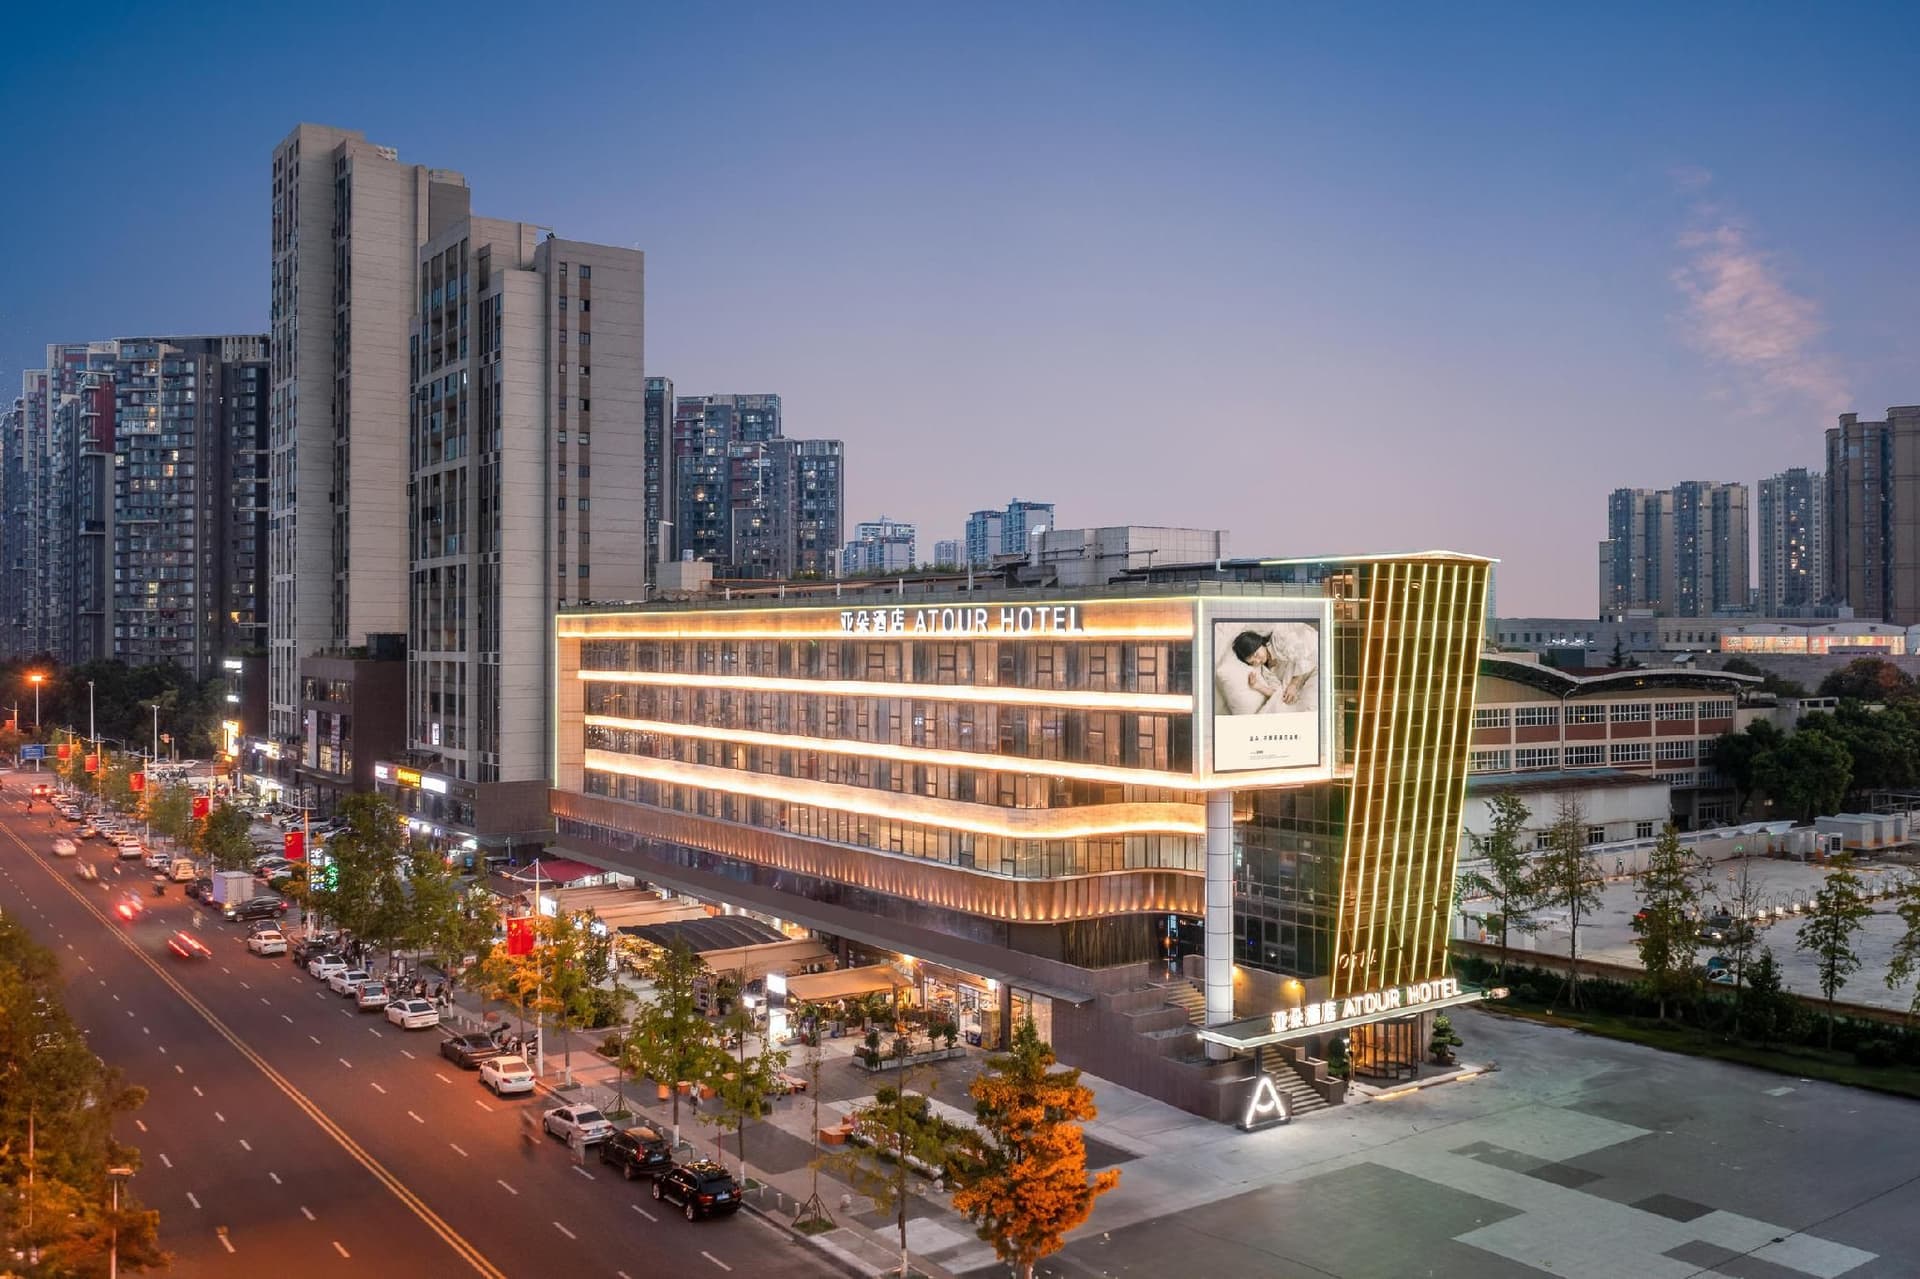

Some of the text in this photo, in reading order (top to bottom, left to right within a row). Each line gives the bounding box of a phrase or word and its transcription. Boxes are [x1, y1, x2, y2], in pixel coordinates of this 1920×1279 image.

[841, 606, 1084, 633] 亚朵酒店 ATOUR HOTEL
[1342, 988, 1400, 1018] ATOUR
[1407, 978, 1462, 1005] HOTEL
